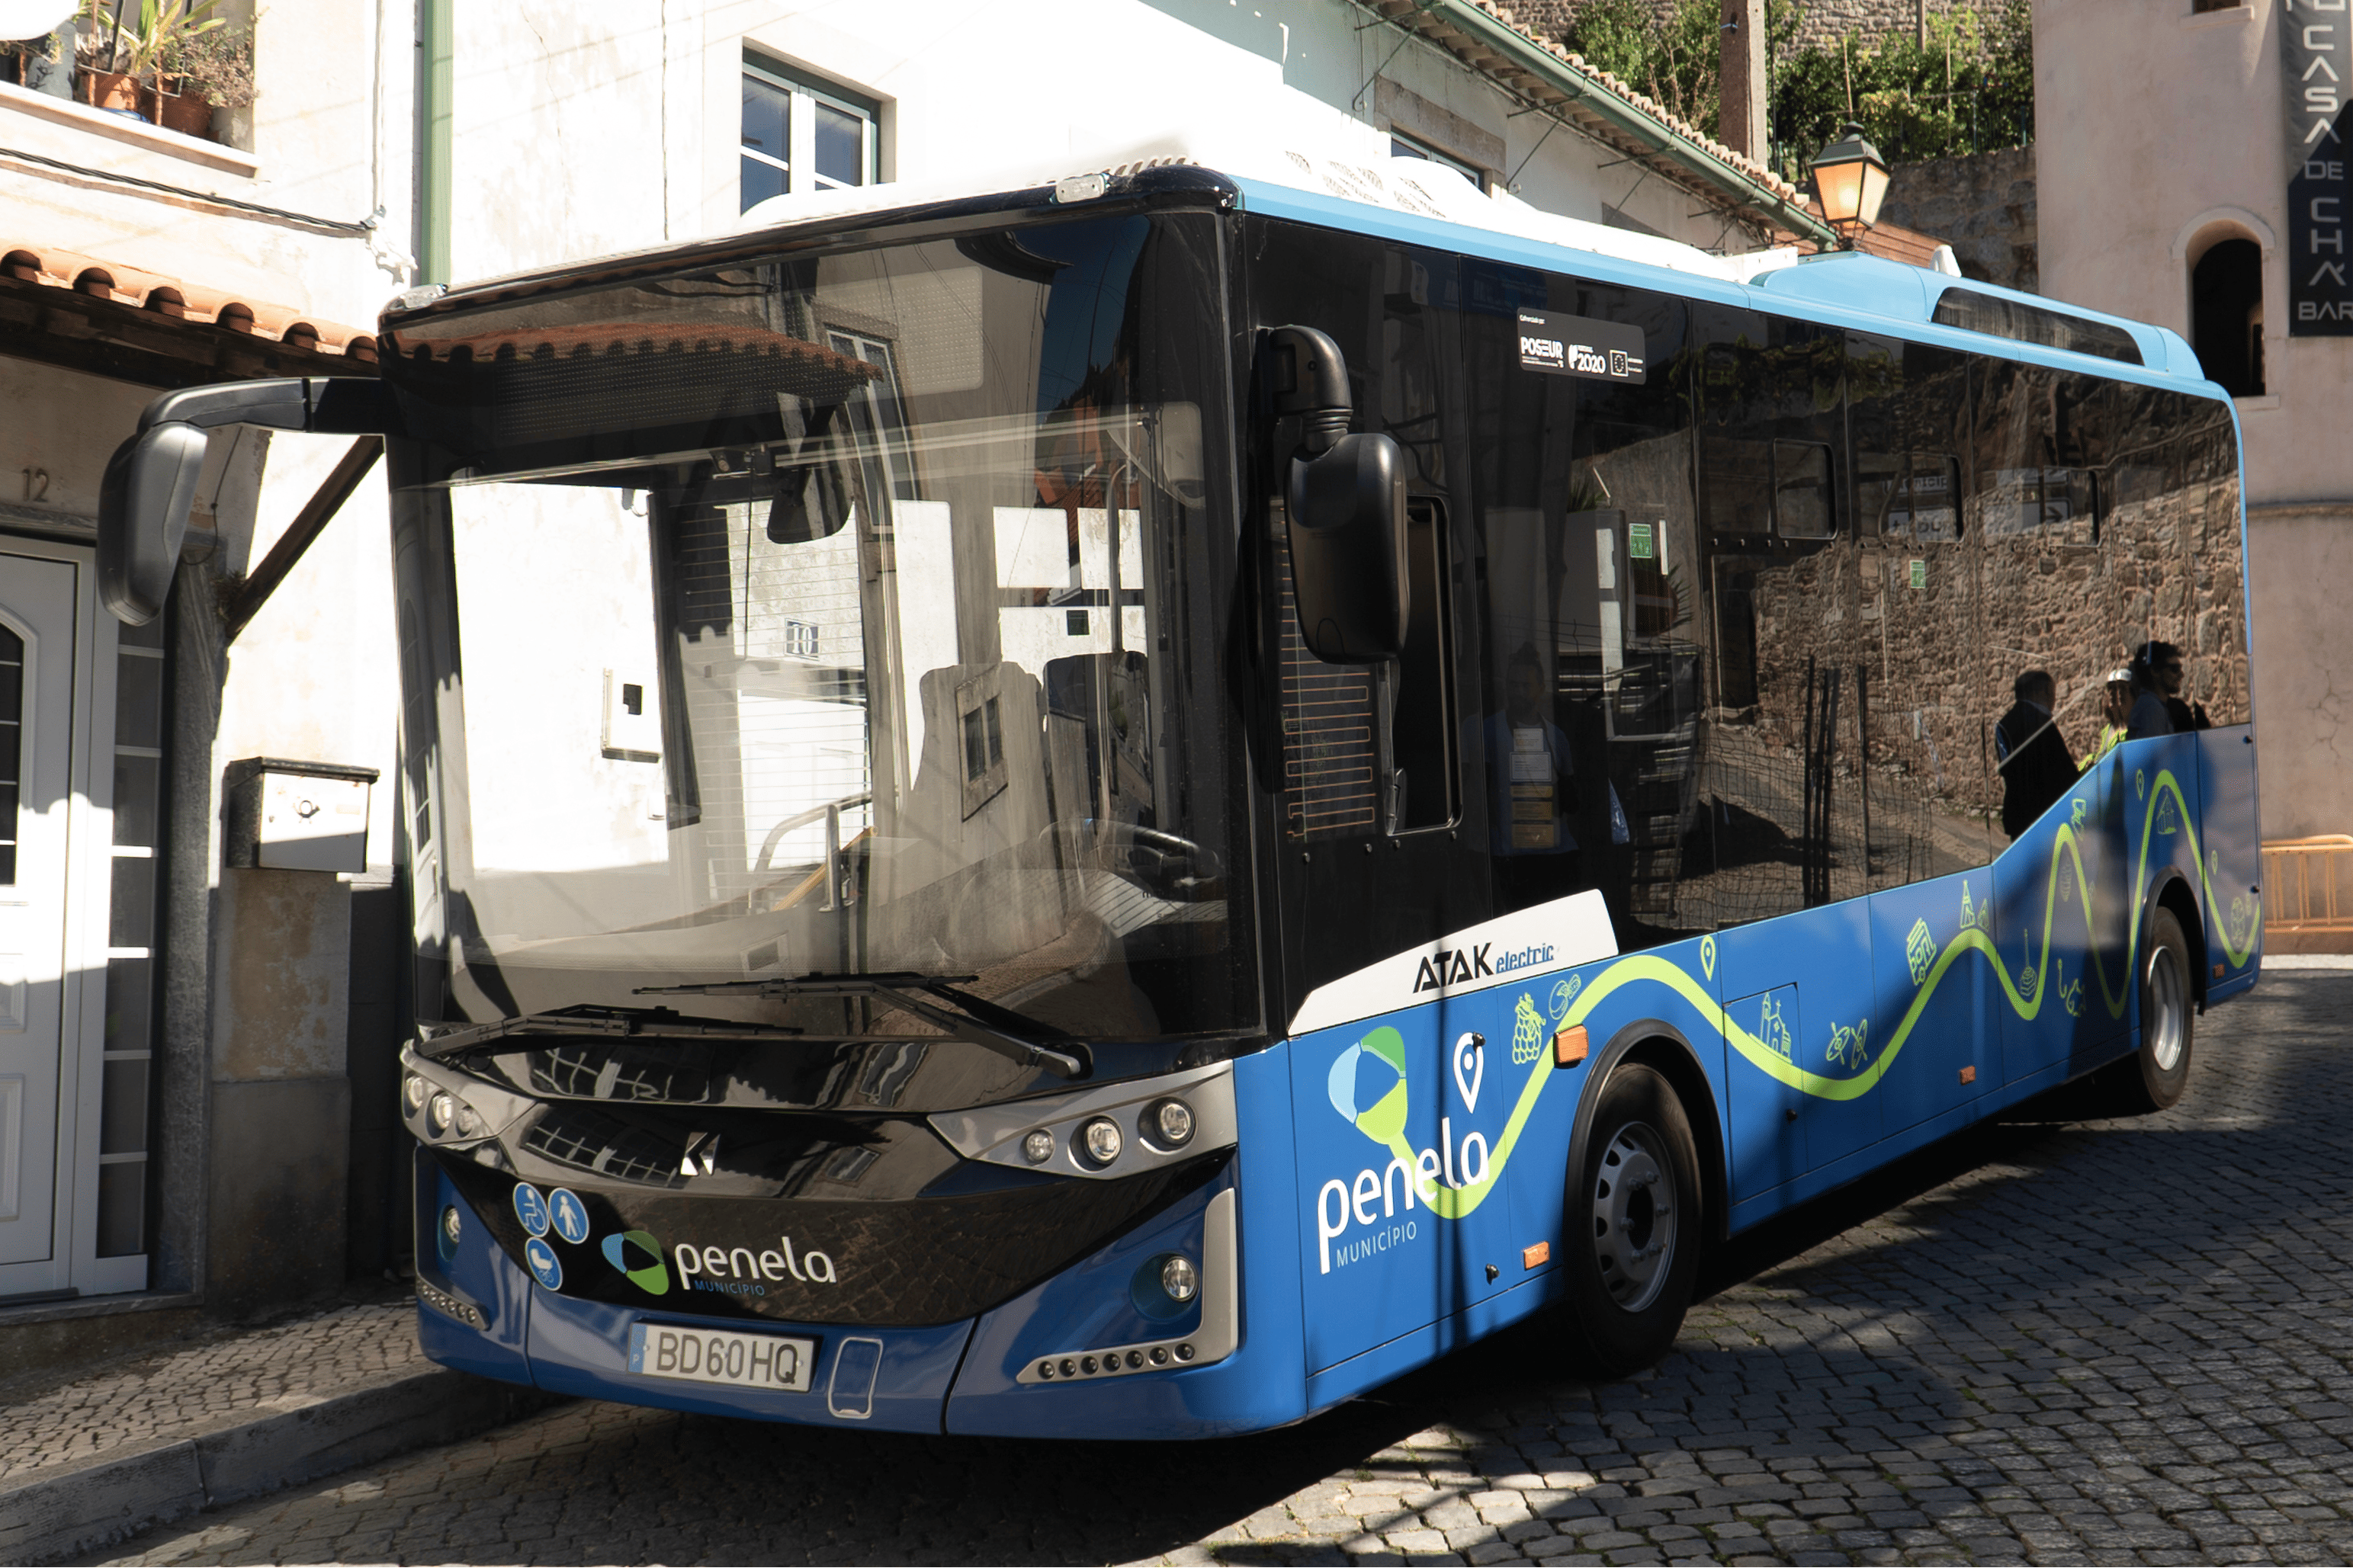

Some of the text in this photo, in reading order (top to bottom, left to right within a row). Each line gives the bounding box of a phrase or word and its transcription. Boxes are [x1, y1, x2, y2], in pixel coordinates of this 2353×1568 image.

[2301, 24, 2342, 144] CASA
[2304, 160, 2344, 181] DE
[2298, 301, 2353, 321] BAR
[1578, 353, 1607, 374] 2020
[22, 468, 50, 503] 12
[792, 624, 814, 655] 10
[1413, 941, 1555, 994] ATAK electric
[1318, 1117, 1489, 1275] penela
[1336, 1221, 1417, 1268] MUNICÍPIO
[674, 1236, 837, 1291] penela
[694, 1279, 766, 1297] MUNICÍPIO
